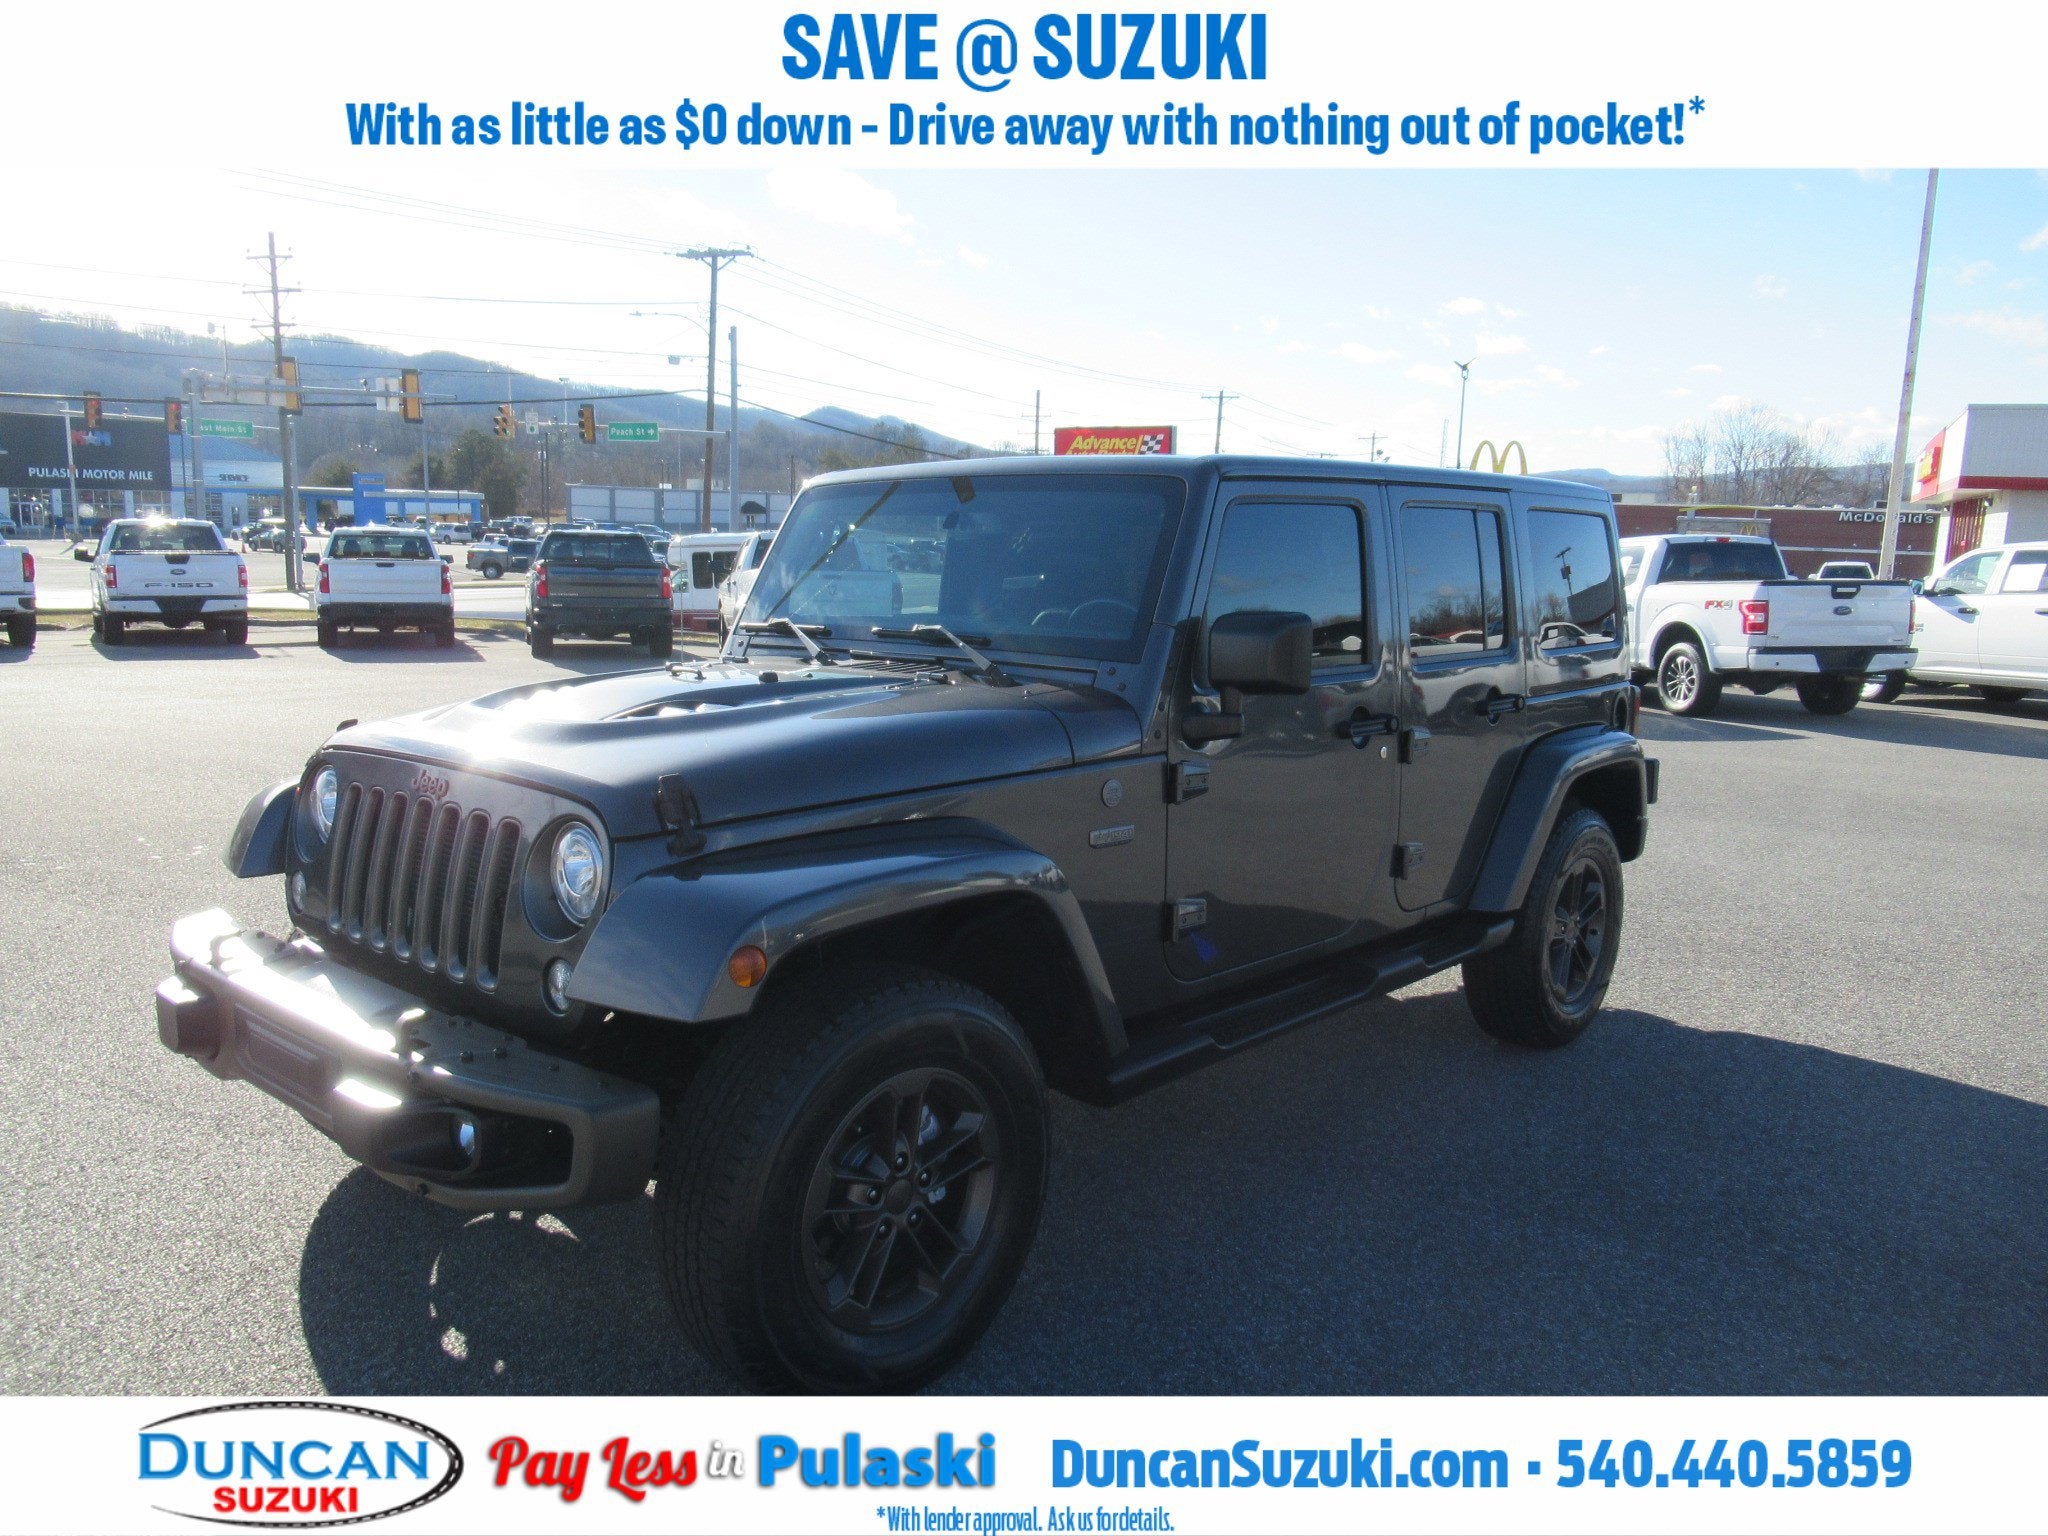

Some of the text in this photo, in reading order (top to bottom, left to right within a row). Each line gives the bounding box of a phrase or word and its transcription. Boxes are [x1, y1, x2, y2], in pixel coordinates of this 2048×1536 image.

[611, 427, 645, 436] Peach St
[1071, 435, 1137, 450] Advance
[82, 469, 125, 480] MOTOR
[128, 470, 153, 480] MILE
[1838, 512, 1934, 524] McDoald's
[1705, 600, 1734, 610] FX4
[412, 769, 450, 800] Jeep
